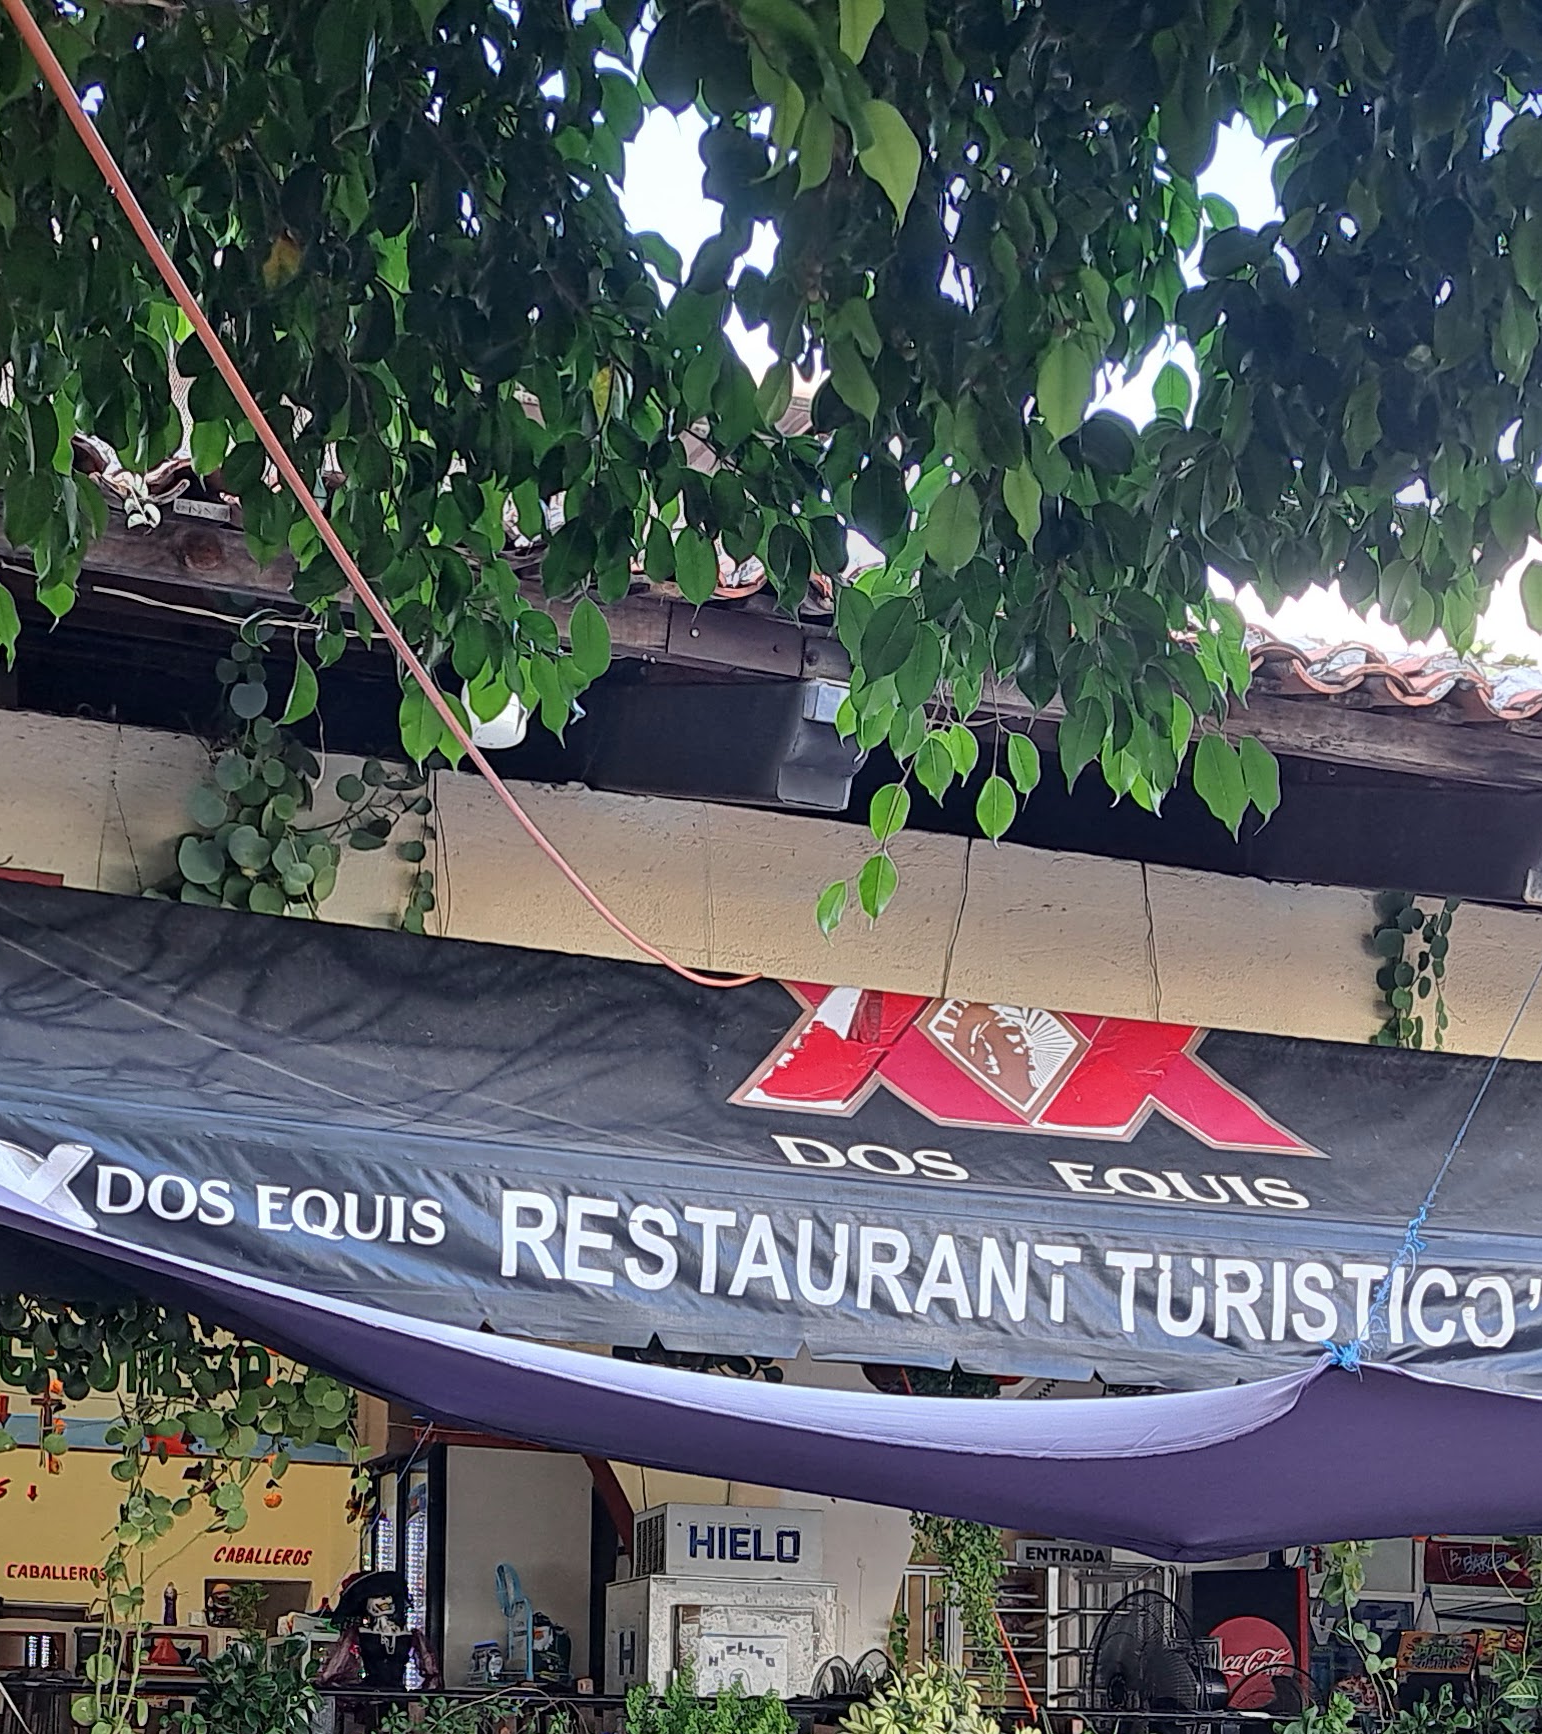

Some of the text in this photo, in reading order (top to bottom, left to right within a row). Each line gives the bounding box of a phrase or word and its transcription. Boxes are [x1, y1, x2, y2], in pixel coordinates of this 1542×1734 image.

[771, 1134, 1312, 1211] DOS EQUIS
[95, 1163, 235, 1227] DOS
[256, 1183, 446, 1248] EQUIS
[500, 1188, 1082, 1326] RESTAURANT
[1105, 1248, 1516, 1349] TURISTICO
[213, 1545, 313, 1567] CABALLEROS
[688, 1521, 802, 1565] HIELO
[1025, 1545, 1106, 1564] ENTRADA
[6, 1563, 108, 1584] CABALLEROS
